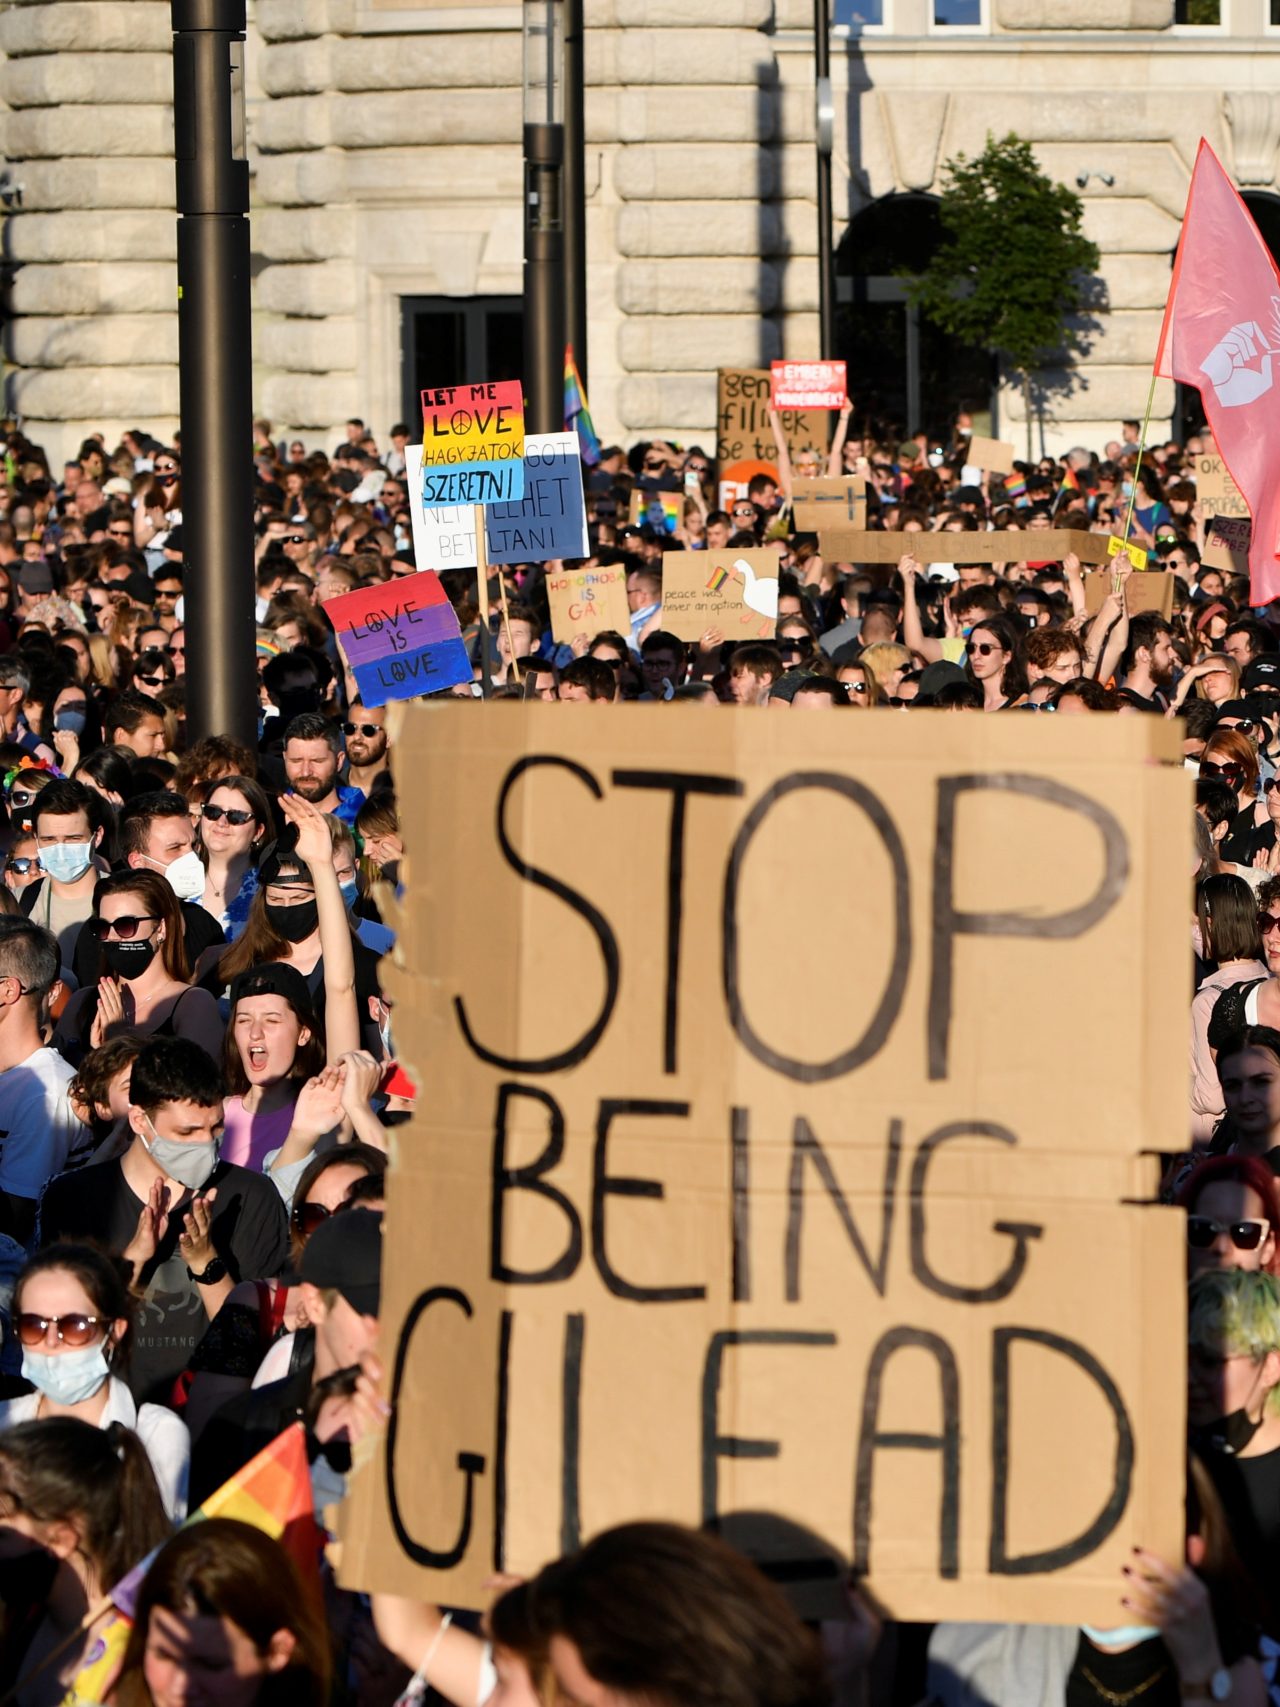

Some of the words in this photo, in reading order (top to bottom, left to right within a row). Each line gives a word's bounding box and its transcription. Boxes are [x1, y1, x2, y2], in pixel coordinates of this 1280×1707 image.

[423, 388, 457, 407] LET
[471, 384, 497, 401] ME
[424, 467, 513, 502] SZERETNI
[1200, 497, 1248, 514] PROPAG
[438, 527, 555, 558] BETLTANI
[1211, 535, 1250, 553] EMBE
[581, 588, 595, 601] IS
[664, 590, 697, 600] peace
[702, 589, 724, 598] was
[568, 601, 606, 620] GAY
[662, 602, 692, 612] never
[695, 602, 708, 611] an
[711, 601, 743, 615] option
[349, 600, 424, 640] LOVE
[377, 652, 439, 687] LOVE
[453, 754, 1132, 1082] STOP
[489, 1082, 1043, 1305] BEING
[137, 1336, 195, 1348] MUSTANG
